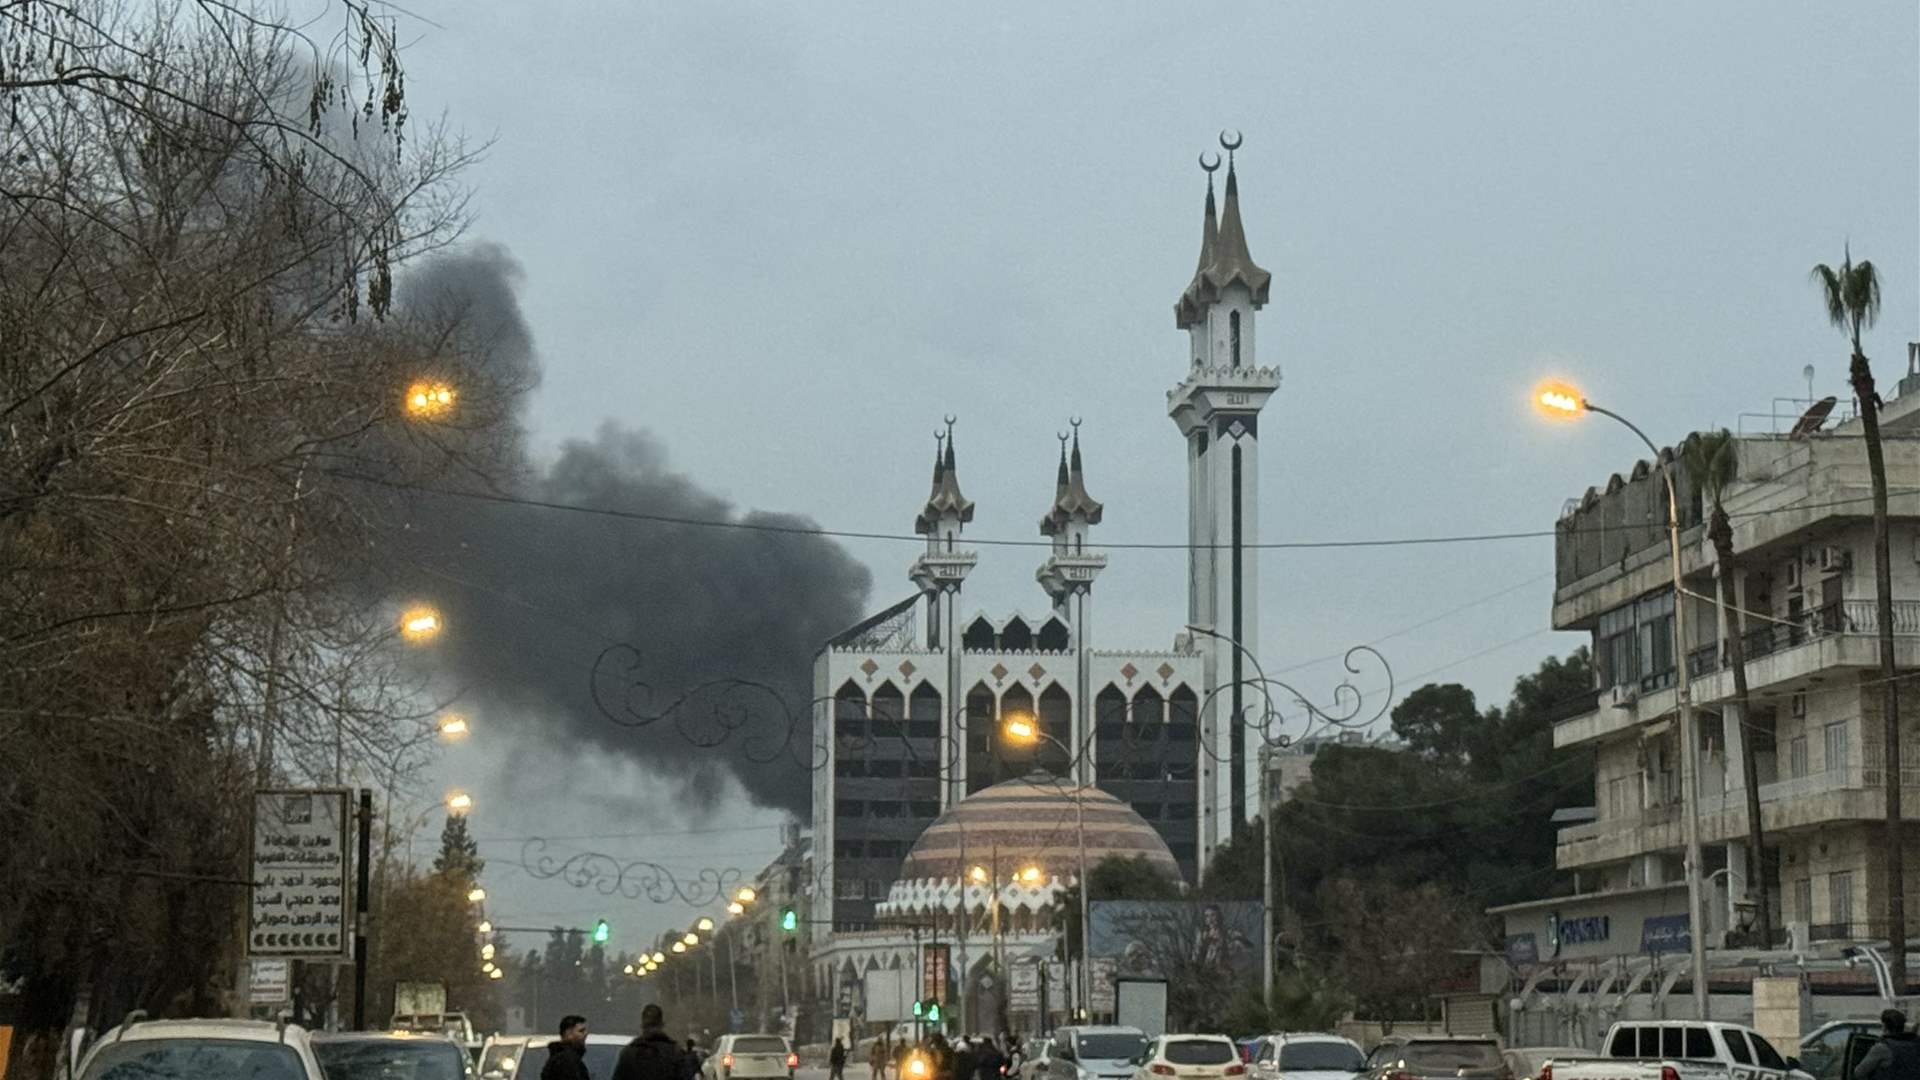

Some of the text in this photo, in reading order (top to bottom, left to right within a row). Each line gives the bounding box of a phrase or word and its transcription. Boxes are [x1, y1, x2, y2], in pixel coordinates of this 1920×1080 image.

[309, 877, 341, 888] محمود
[319, 895, 340, 906] محمد
[324, 914, 340, 927] عبد
